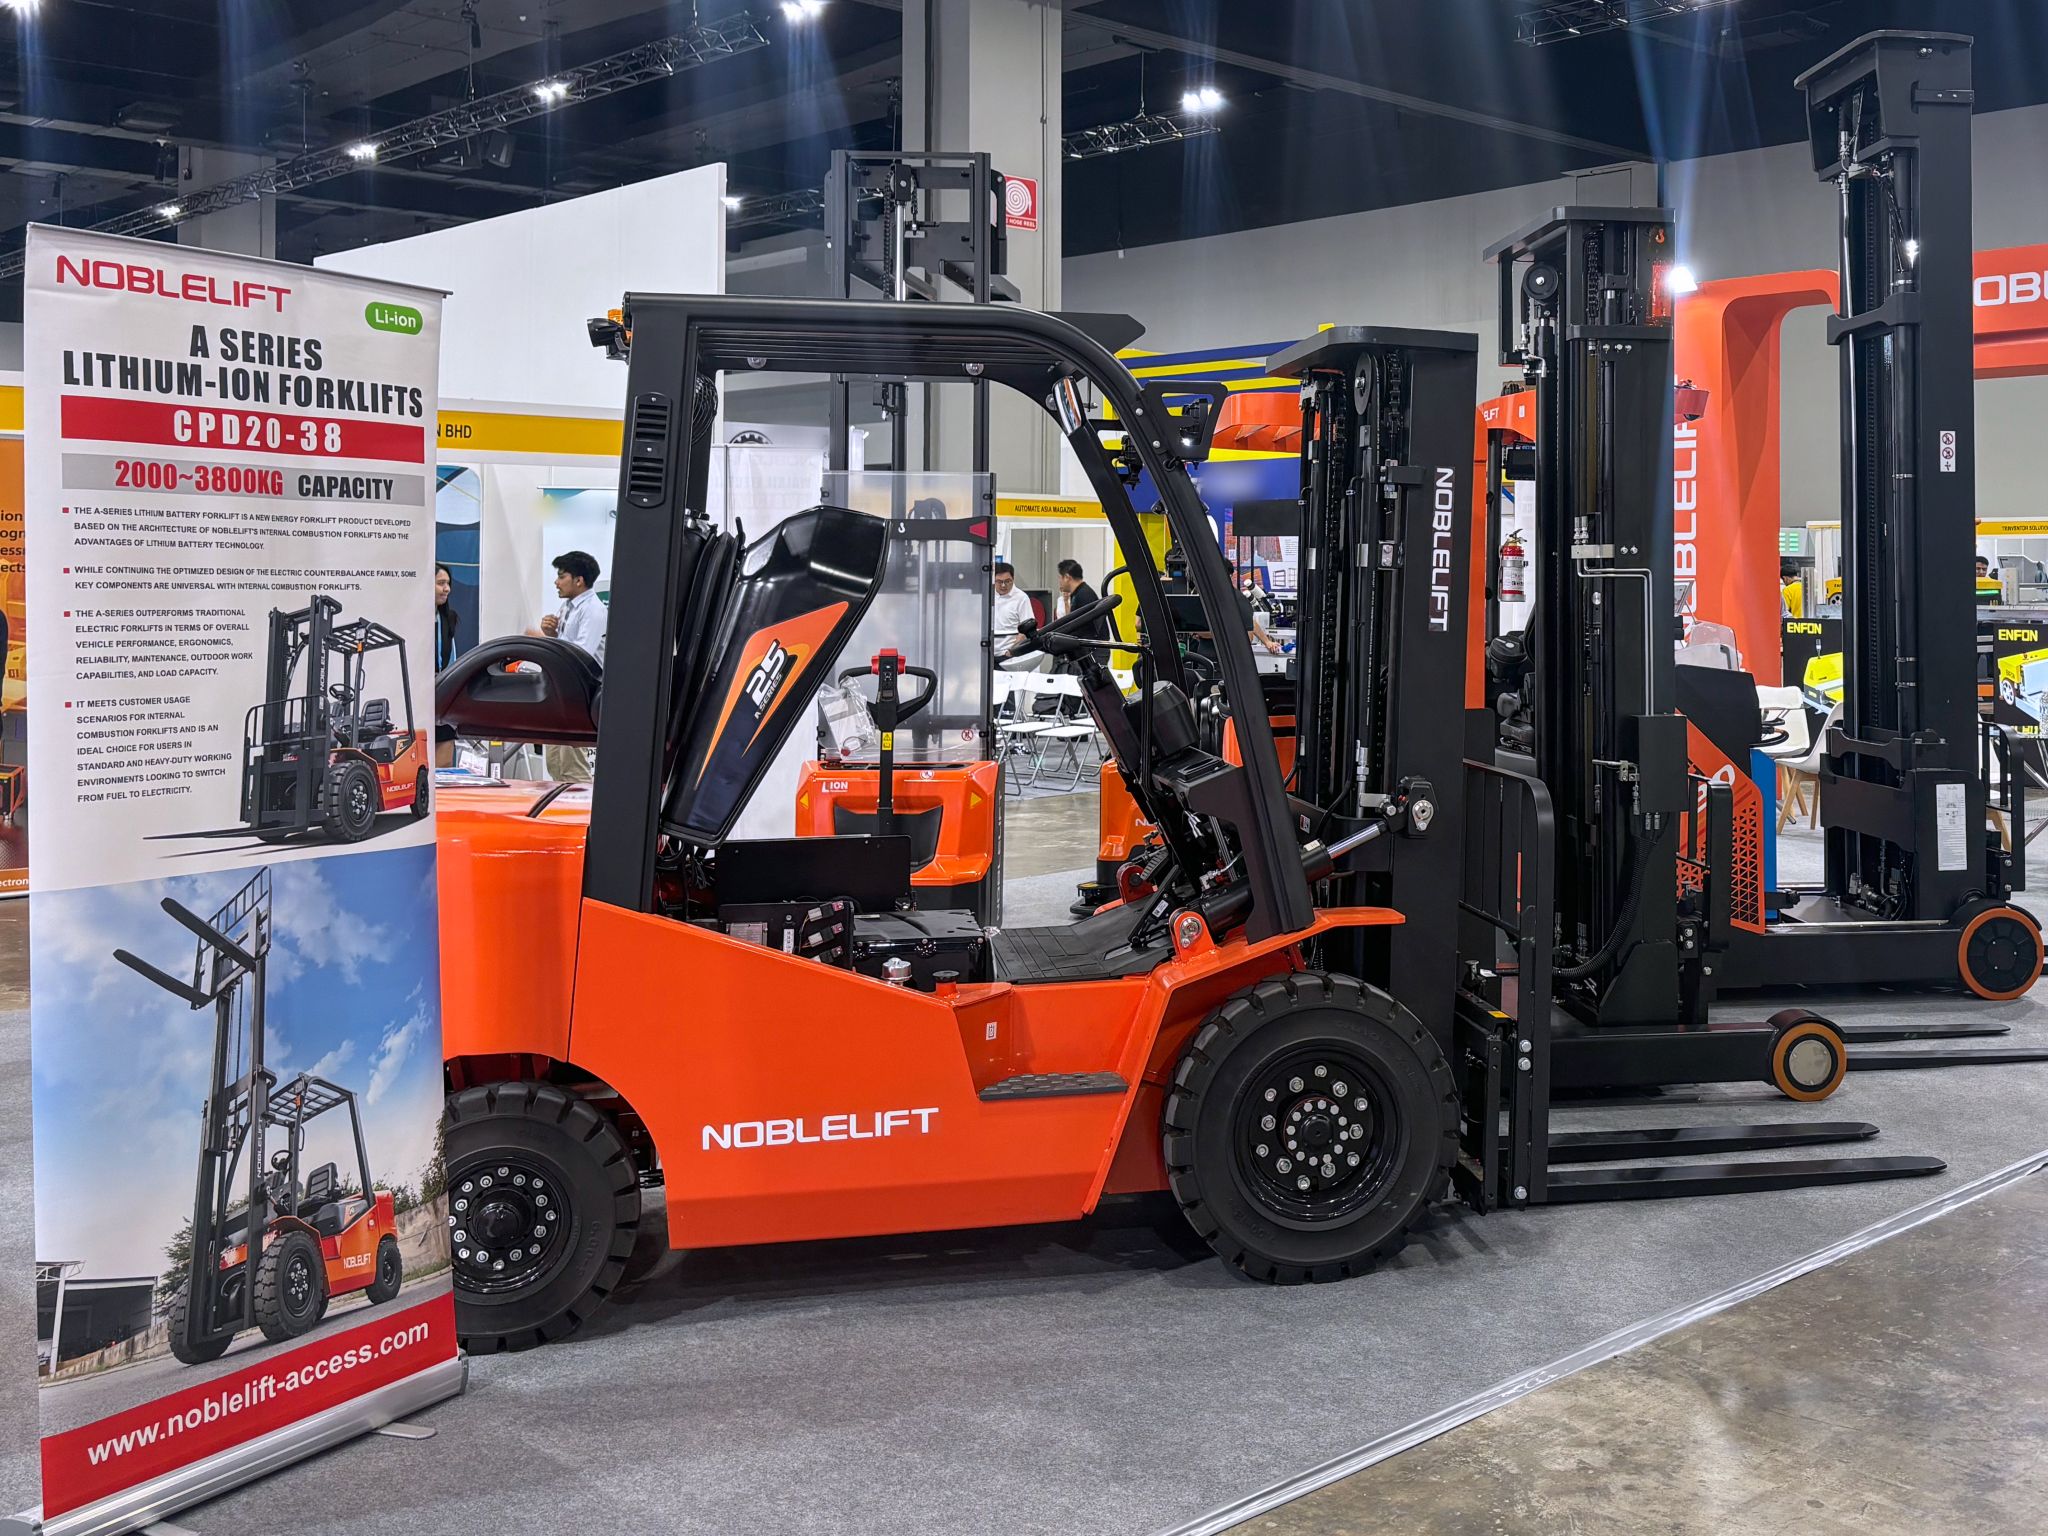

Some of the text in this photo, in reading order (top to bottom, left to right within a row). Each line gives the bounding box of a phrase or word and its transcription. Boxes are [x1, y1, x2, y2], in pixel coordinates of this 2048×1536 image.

[57, 255, 291, 312] NOBLELIFT
[1974, 272, 2048, 306] OB
[376, 308, 416, 328] Li-ion
[190, 325, 322, 371] A SERIES
[64, 350, 422, 418] LITHIUM-ION FORKLIFTS
[174, 409, 342, 453] CPD20-38
[446, 424, 472, 438] BHD
[114, 460, 394, 500] 2000~3800KG CAPACITY
[74, 507, 92, 515] THE
[94, 508, 133, 516] A-SERIES
[134, 509, 164, 518] LITHIUM
[166, 510, 200, 519] BATTERY
[202, 512, 239, 520] FORKLIFT
[300, 516, 336, 524] FORKLIFT
[1014, 505, 1077, 514] AUTOMATE ASIA MAGAZINE
[139, 525, 197, 533] ARCHITECTURE
[212, 527, 258, 535] NOBLELIFT'S
[292, 530, 342, 538] COMBUSTION
[74, 539, 132, 547] ADVANTAGES
[1430, 468, 1454, 632] NOBLELIFT
[1786, 622, 1822, 634] ENFON
[1998, 629, 2038, 642] ENFON
[116, 640, 177, 648] PERFORMANCE,
[178, 639, 233, 647] ERGONOMICS,
[76, 656, 130, 664] RELIABILITY,
[131, 654, 189, 663] MAINTENANCE,
[76, 671, 136, 680] CAPABILITIES,
[179, 668, 219, 676] CAPACITY.
[746, 640, 784, 706] 25
[760, 673, 782, 712] SERIES
[87, 699, 117, 708] MEETS
[118, 697, 162, 706] CUSTOMER
[163, 696, 191, 705] USAGE
[76, 714, 128, 724] SCENARIOS
[147, 712, 185, 721] INTERNAL
[76, 729, 134, 739] COMBUSTION
[136, 726, 178, 736] FORKLIFTS
[179, 725, 196, 733] AND
[77, 746, 104, 755] IDEAL
[106, 744, 137, 753] CHOICE
[138, 743, 155, 751] FOR
[156, 742, 182, 750] USERS
[77, 753, 232, 771] STANDARD AND HEAVY-DUTY WORKING
[77, 768, 226, 786] ENVIRONMENTS LOOKING TO SWITCH
[77, 786, 192, 802] FROM FUEL TO ELECTRICITY.
[386, 783, 414, 792] NOBLELIFT
[702, 1108, 940, 1150] NOBLELIFT
[344, 1253, 371, 1270] NOBLELIFT
[88, 1322, 429, 1465] www.noblelift-access.com
